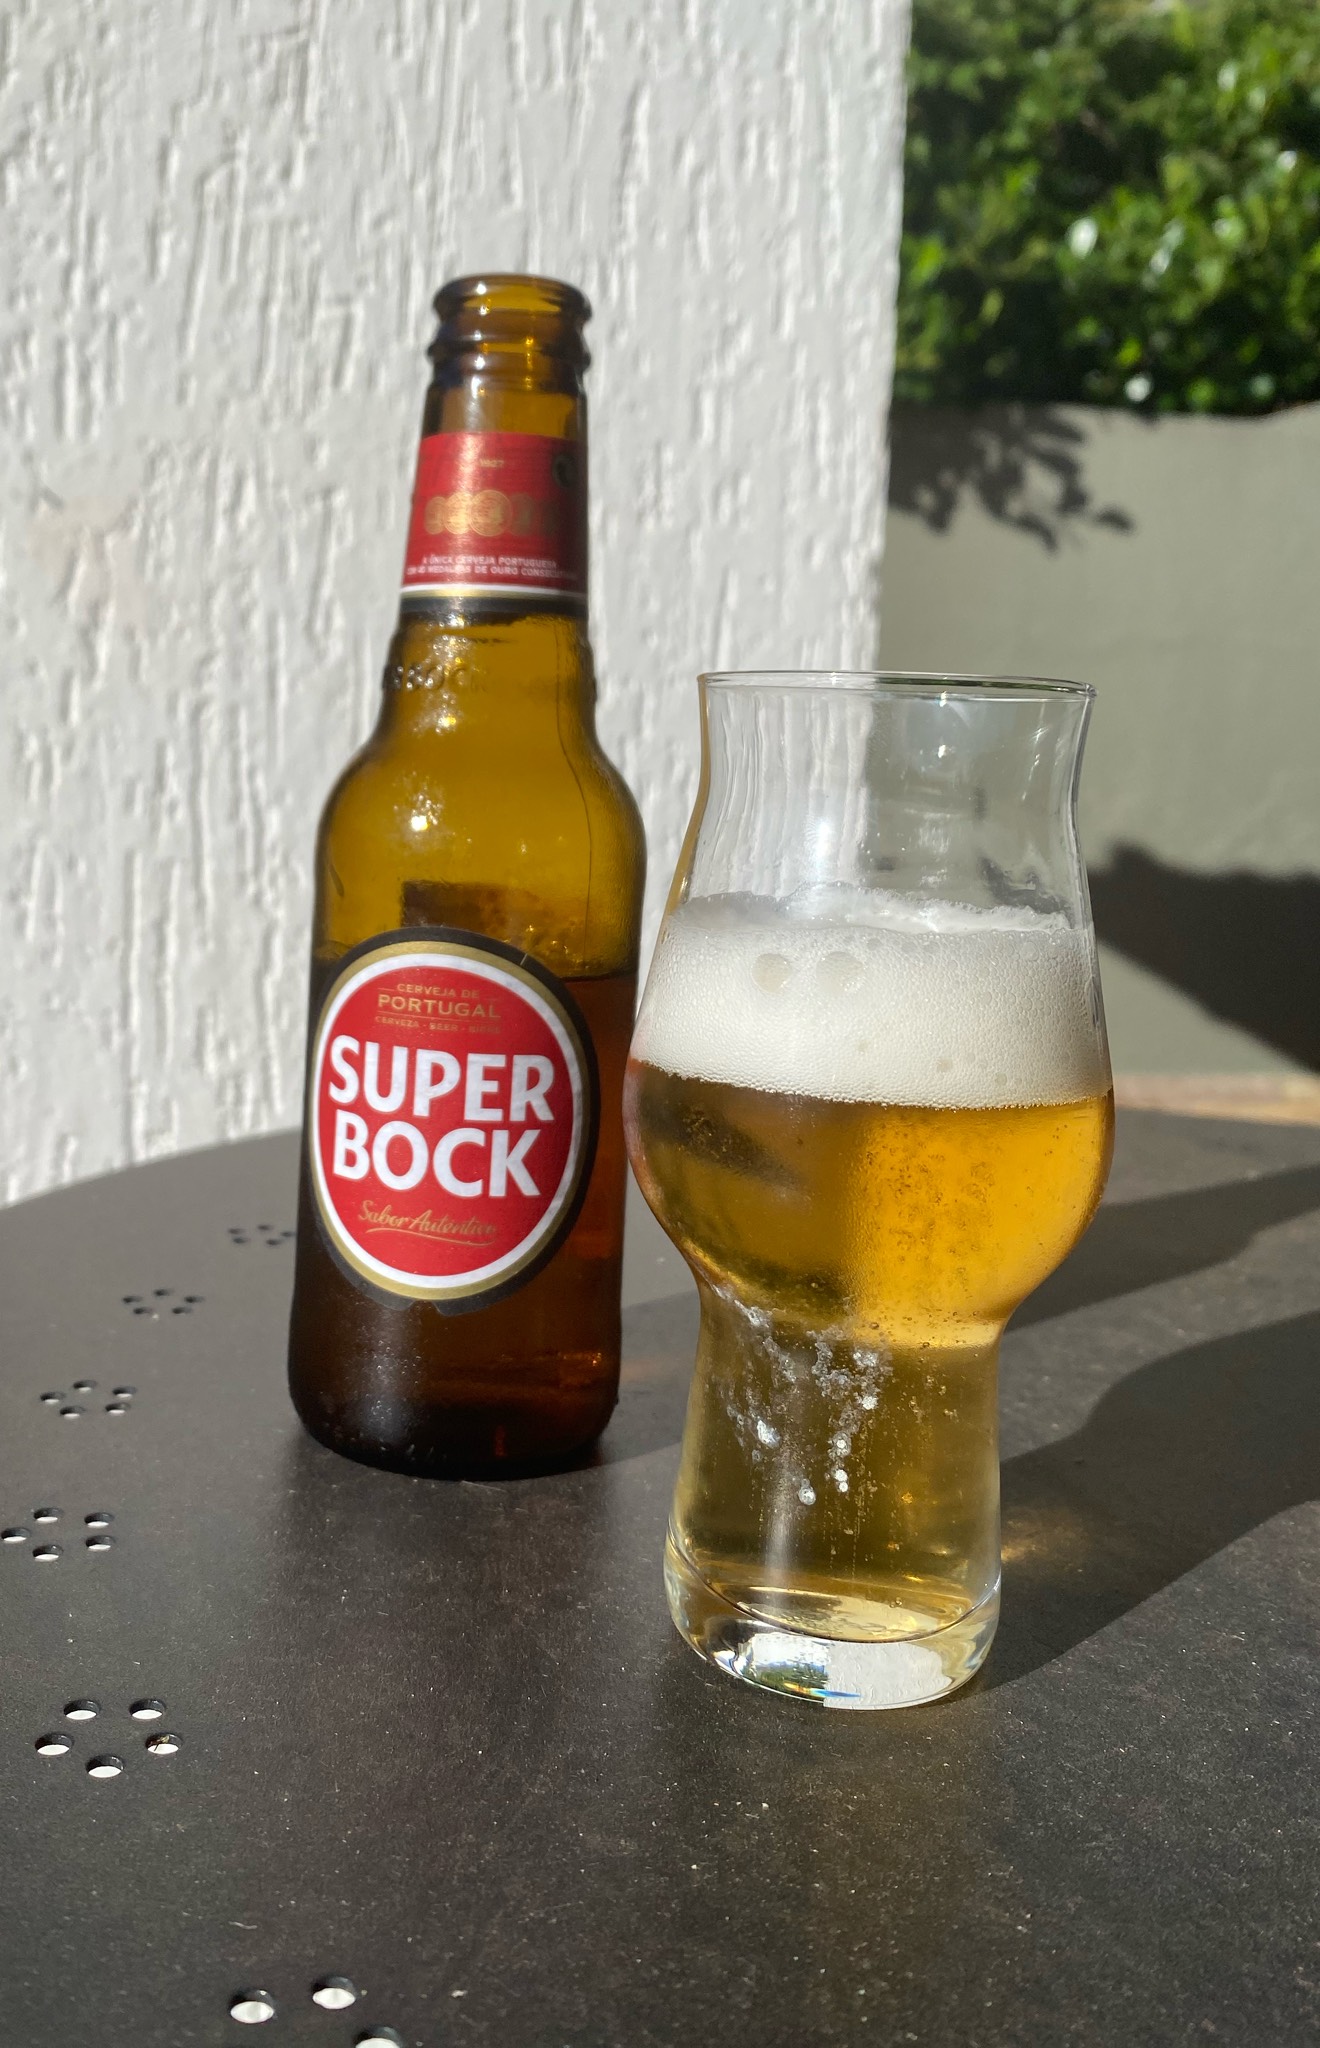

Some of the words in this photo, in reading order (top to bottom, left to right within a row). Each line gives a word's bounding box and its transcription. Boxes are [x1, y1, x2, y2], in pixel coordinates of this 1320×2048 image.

[474, 566, 488, 575] DE
[490, 566, 518, 576] OURO
[397, 983, 456, 997] CERVEJA
[461, 989, 480, 999] DE
[378, 994, 501, 1018] PORTUGAL
[375, 1015, 419, 1028] CERVEZA
[429, 1022, 459, 1031] BEER
[328, 1034, 555, 1122] SUPER
[333, 1110, 541, 1197] BOCK
[358, 1199, 409, 1227] Sabor
